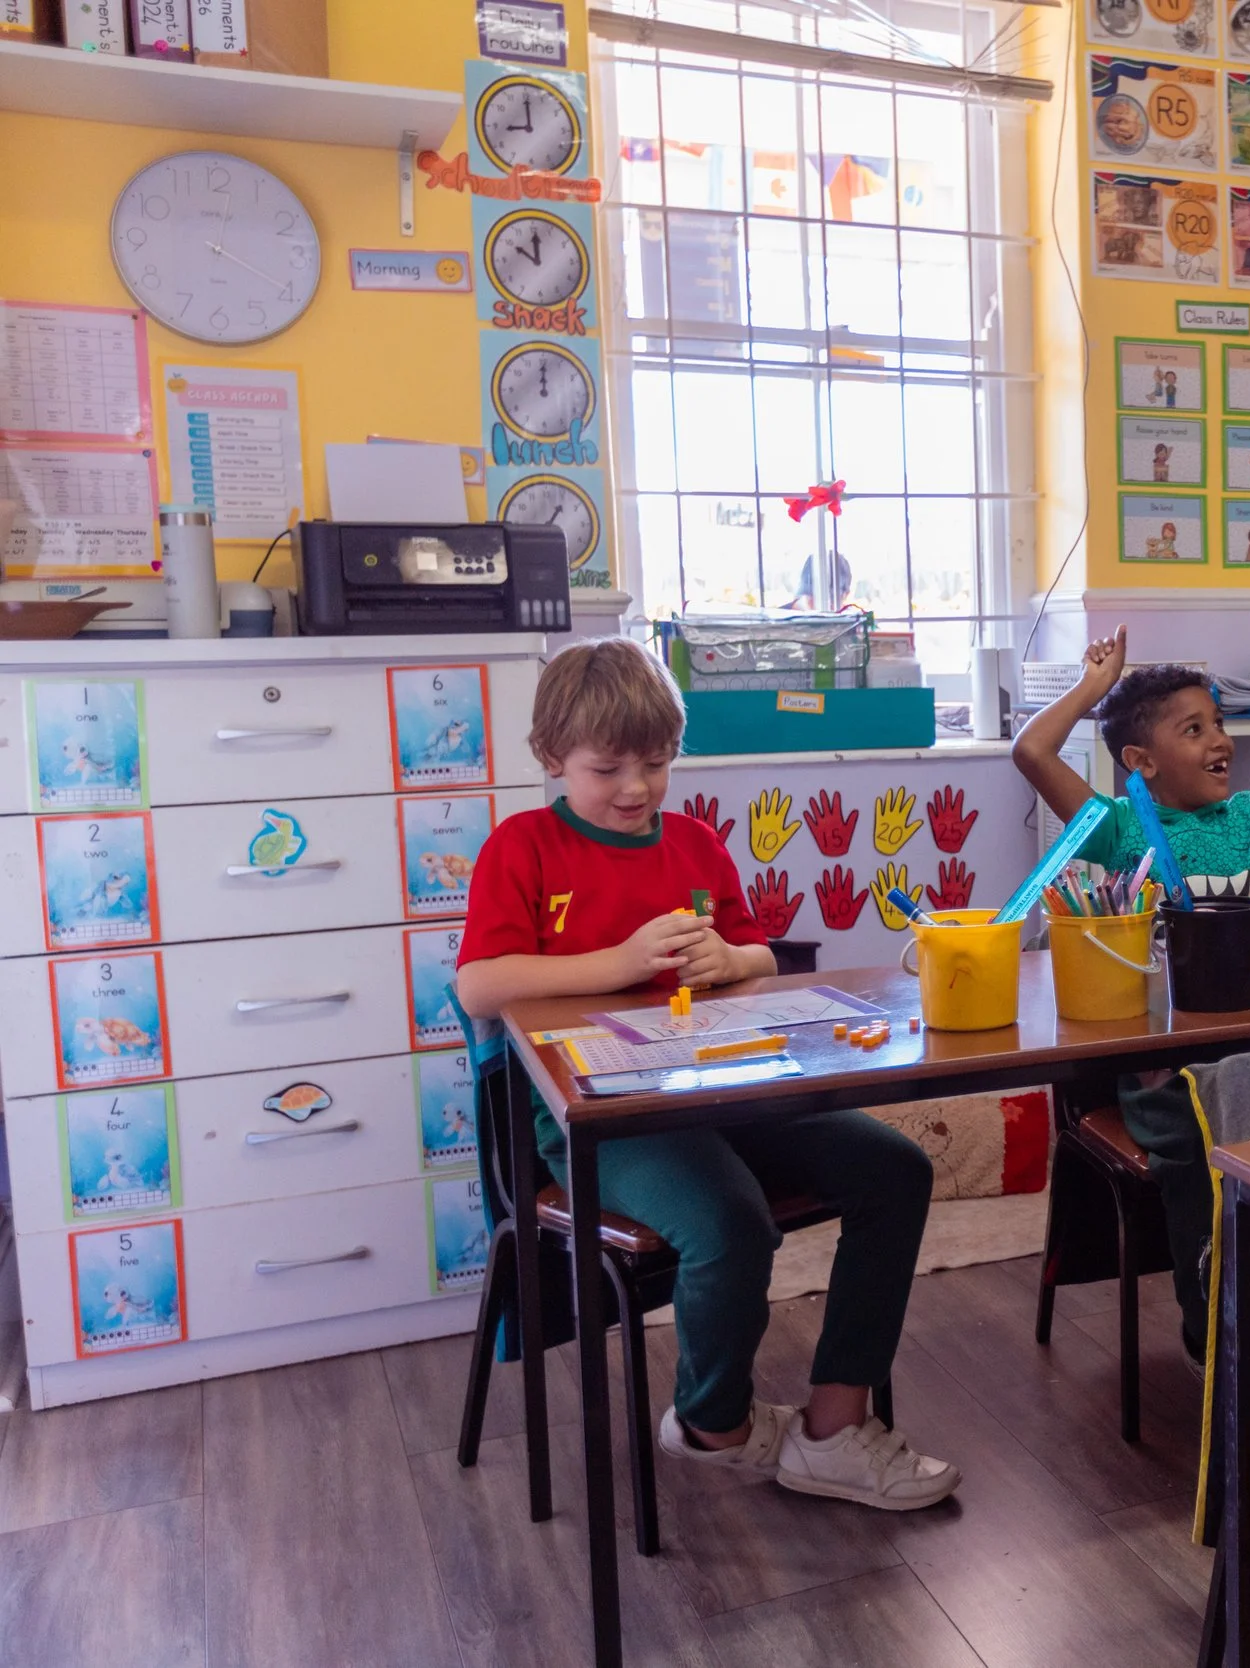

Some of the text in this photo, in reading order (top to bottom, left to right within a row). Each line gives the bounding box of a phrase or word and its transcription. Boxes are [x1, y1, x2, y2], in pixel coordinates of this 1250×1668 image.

[1156, 96, 1189, 126] R5
[205, 165, 232, 195] 12
[139, 193, 171, 222] 10
[274, 210, 296, 237] 2
[1175, 213, 1210, 235] R20
[126, 226, 148, 252] 9
[141, 264, 162, 291] 8
[357, 260, 421, 281] Morning
[175, 291, 194, 318] 7
[209, 305, 230, 331] 6
[1183, 309, 1247, 326] Class Rules
[432, 673, 444, 692] 6
[83, 687, 89, 706] 1
[433, 698, 448, 708] six
[75, 712, 99, 723] one
[442, 801, 453, 821] 7
[88, 823, 102, 843] 2
[432, 825, 464, 836] seven
[757, 830, 779, 851] 10
[822, 826, 844, 849] 15
[876, 821, 904, 843] 20
[938, 821, 963, 843] 25
[83, 848, 109, 859] two
[549, 890, 573, 934] 7
[760, 905, 787, 930] 35
[827, 897, 851, 922] 40
[447, 933, 459, 951] 8
[100, 962, 113, 982] 3
[441, 956, 459, 970] eig
[91, 985, 127, 998] three
[456, 1056, 468, 1074] 9
[109, 1096, 125, 1117] 4
[105, 1118, 132, 1132] four
[119, 1232, 134, 1252] 5
[118, 1254, 140, 1268] five
